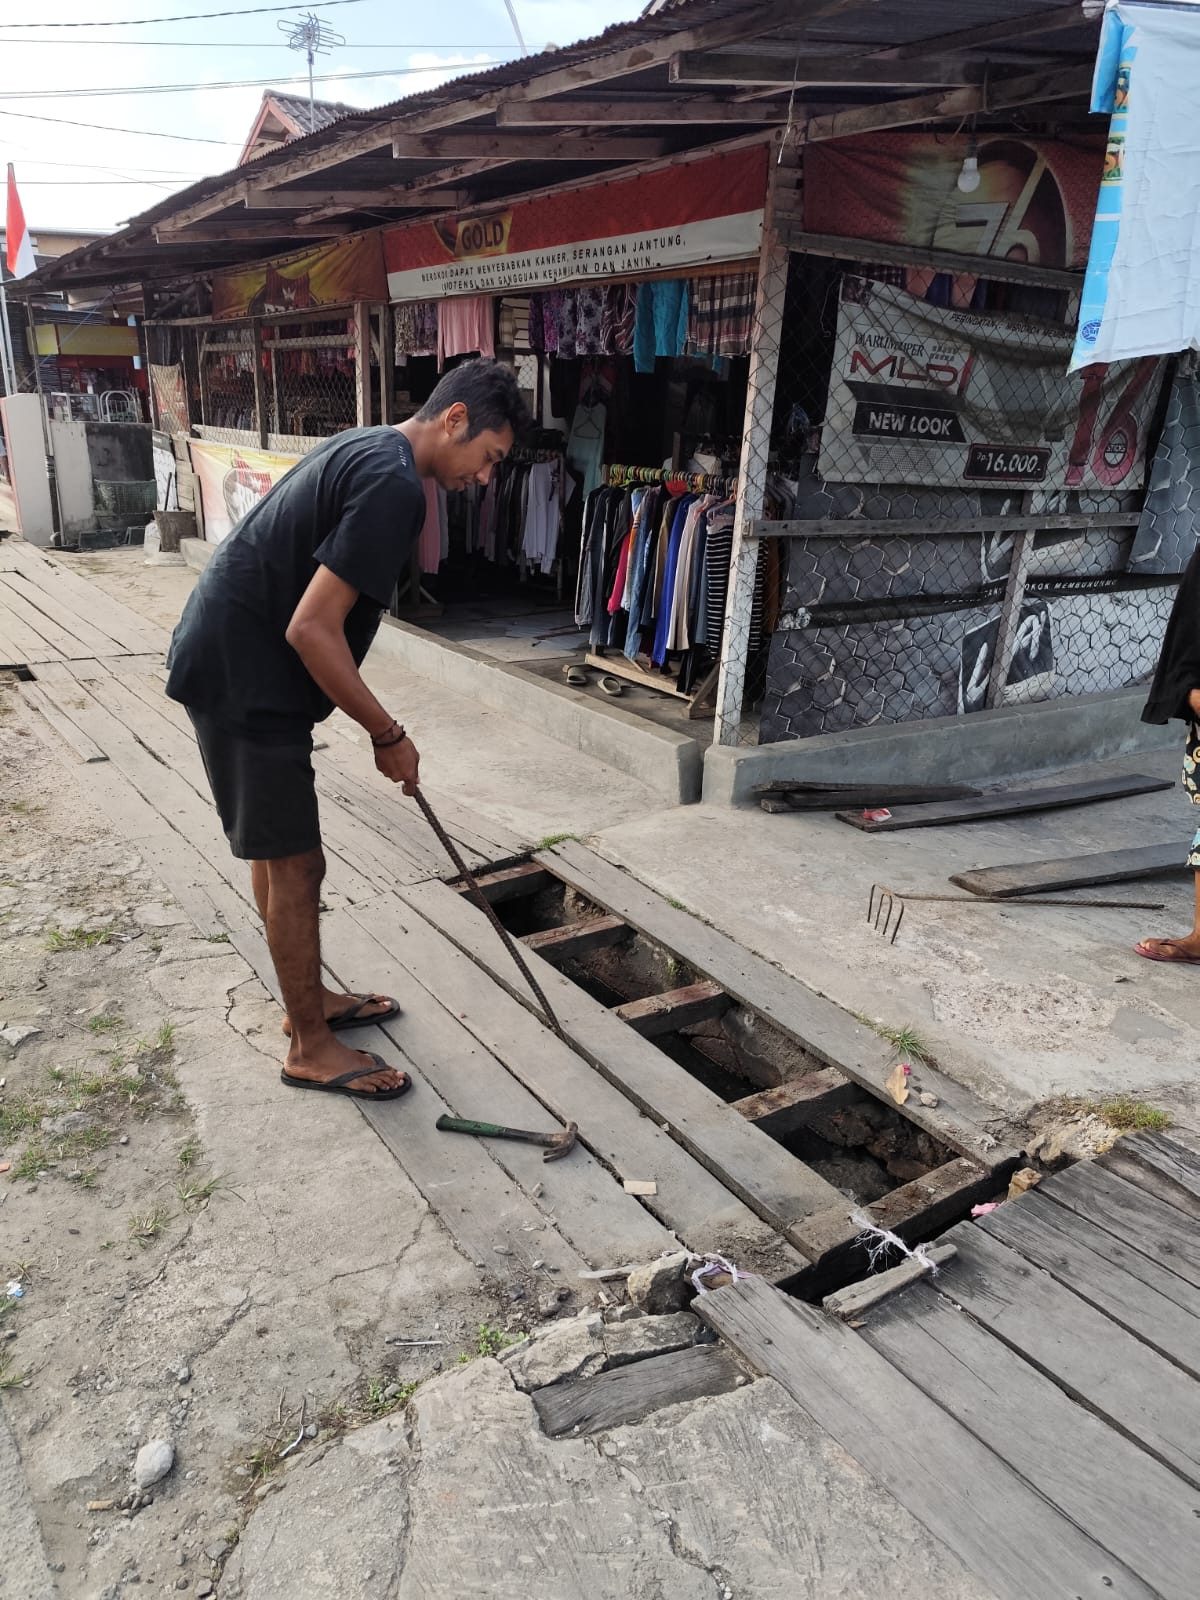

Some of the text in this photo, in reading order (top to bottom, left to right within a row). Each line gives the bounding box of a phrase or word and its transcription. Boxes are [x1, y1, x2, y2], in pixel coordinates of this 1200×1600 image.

[461, 219, 504, 250] GOLD
[450, 266, 474, 278] DAPAT
[477, 259, 531, 275] MENYEBABKAN
[572, 244, 627, 260] SERANGAN
[480, 277, 495, 287] DAN
[498, 272, 539, 286] GANGGUAN
[543, 264, 588, 281] KEHAMILAN
[594, 261, 615, 272] DAN
[868, 410, 954, 436] NEW LOOK
